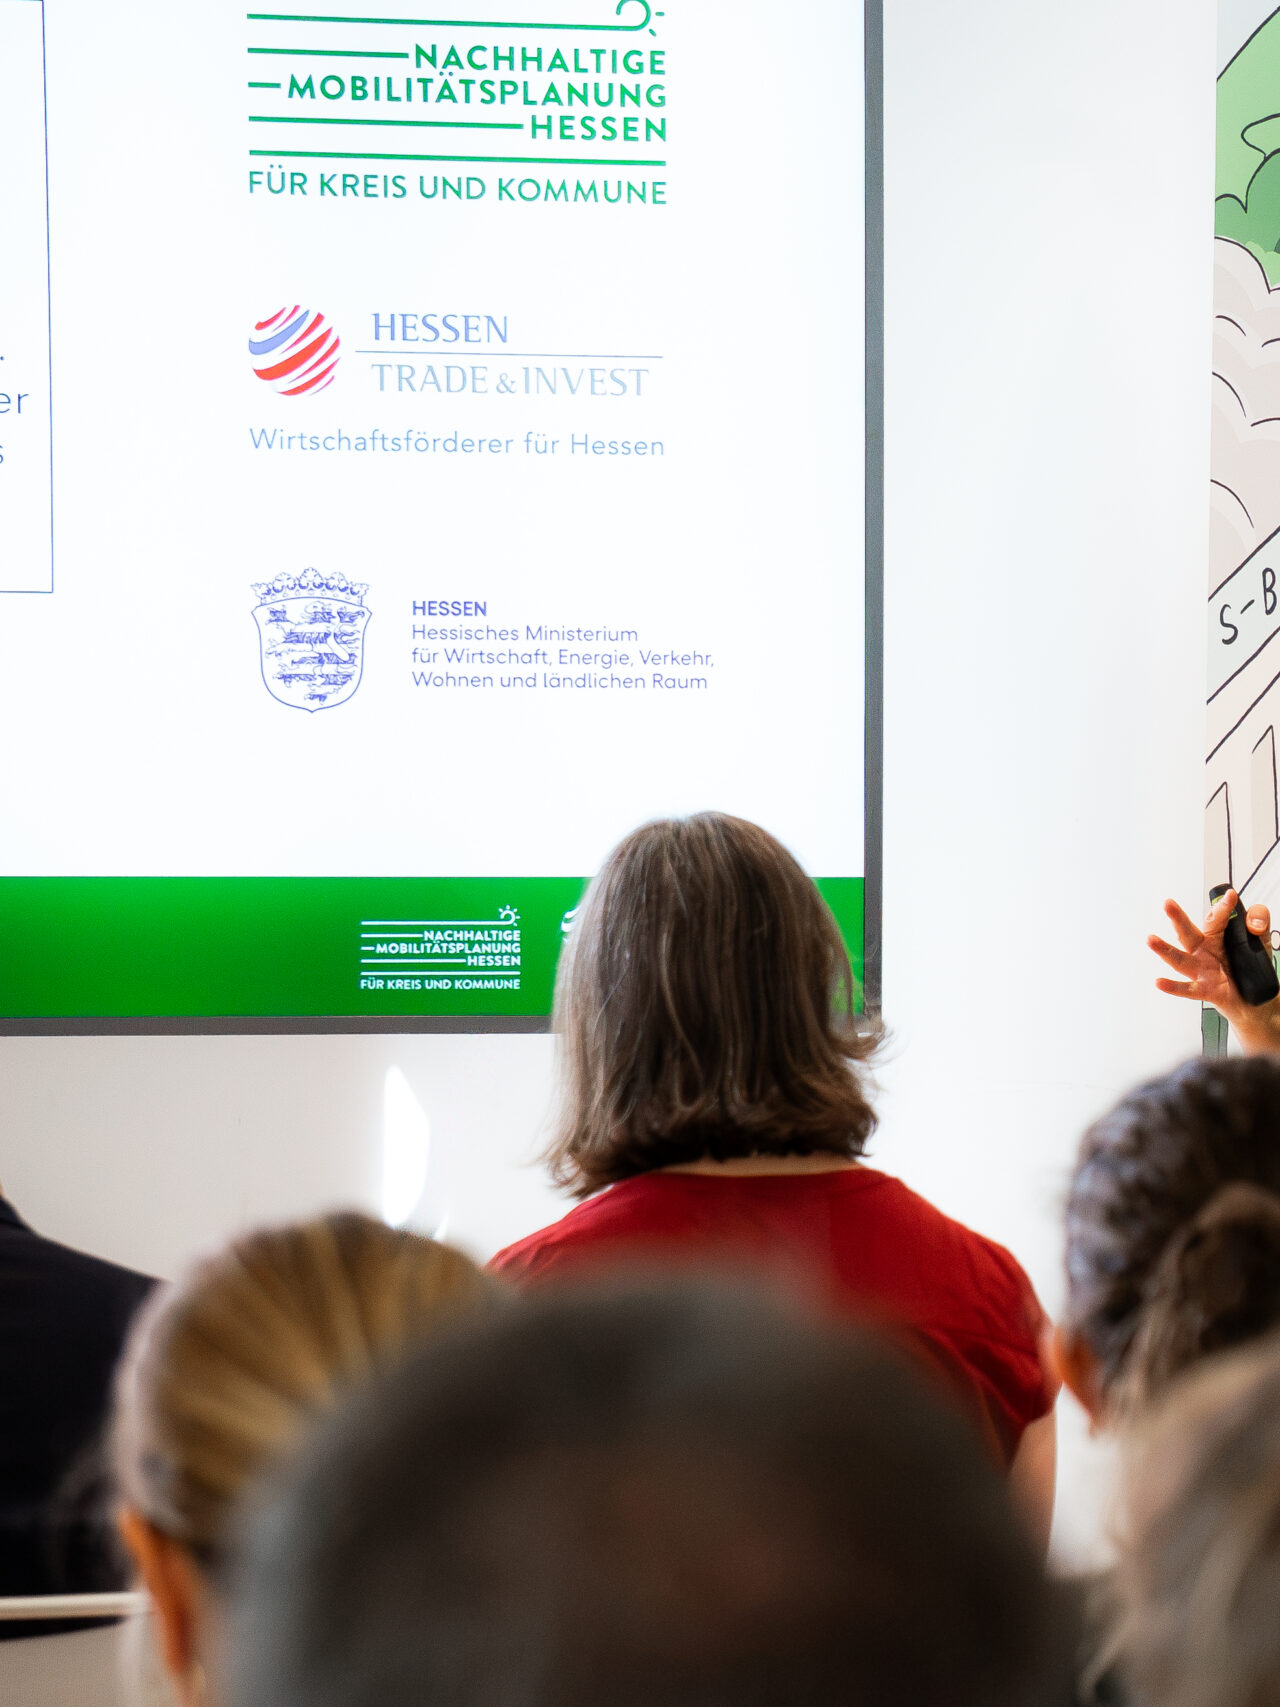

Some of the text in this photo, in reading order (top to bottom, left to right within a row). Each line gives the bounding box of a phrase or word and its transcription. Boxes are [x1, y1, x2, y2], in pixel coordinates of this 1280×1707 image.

[415, 43, 666, 76] NACHHALTIGE
[287, 69, 667, 108] MOBILITÄTSPLANUNG
[530, 114, 667, 143] HESSEN
[248, 165, 667, 205] FÜR KREIS UND KOMMUNE
[371, 312, 508, 344] HESSEN
[371, 363, 489, 394] TRADE
[523, 366, 650, 396] INVEST
[248, 428, 665, 456] Wirtschaftsförderer für Hessen
[412, 600, 488, 617] HESSEN
[412, 624, 638, 642] Hessisches Ministerium
[412, 648, 714, 670] für Wirtschaft, Energie, Verkehr,
[412, 671, 708, 689] Wohnen und ländlichen Raum
[375, 940, 521, 954] MOBILITÄTSPLANUNG
[423, 930, 521, 942] NACHHALTIGE
[466, 955, 521, 967] HESSEN
[360, 977, 521, 990] FÜR KREIS UND KOMMUNE
